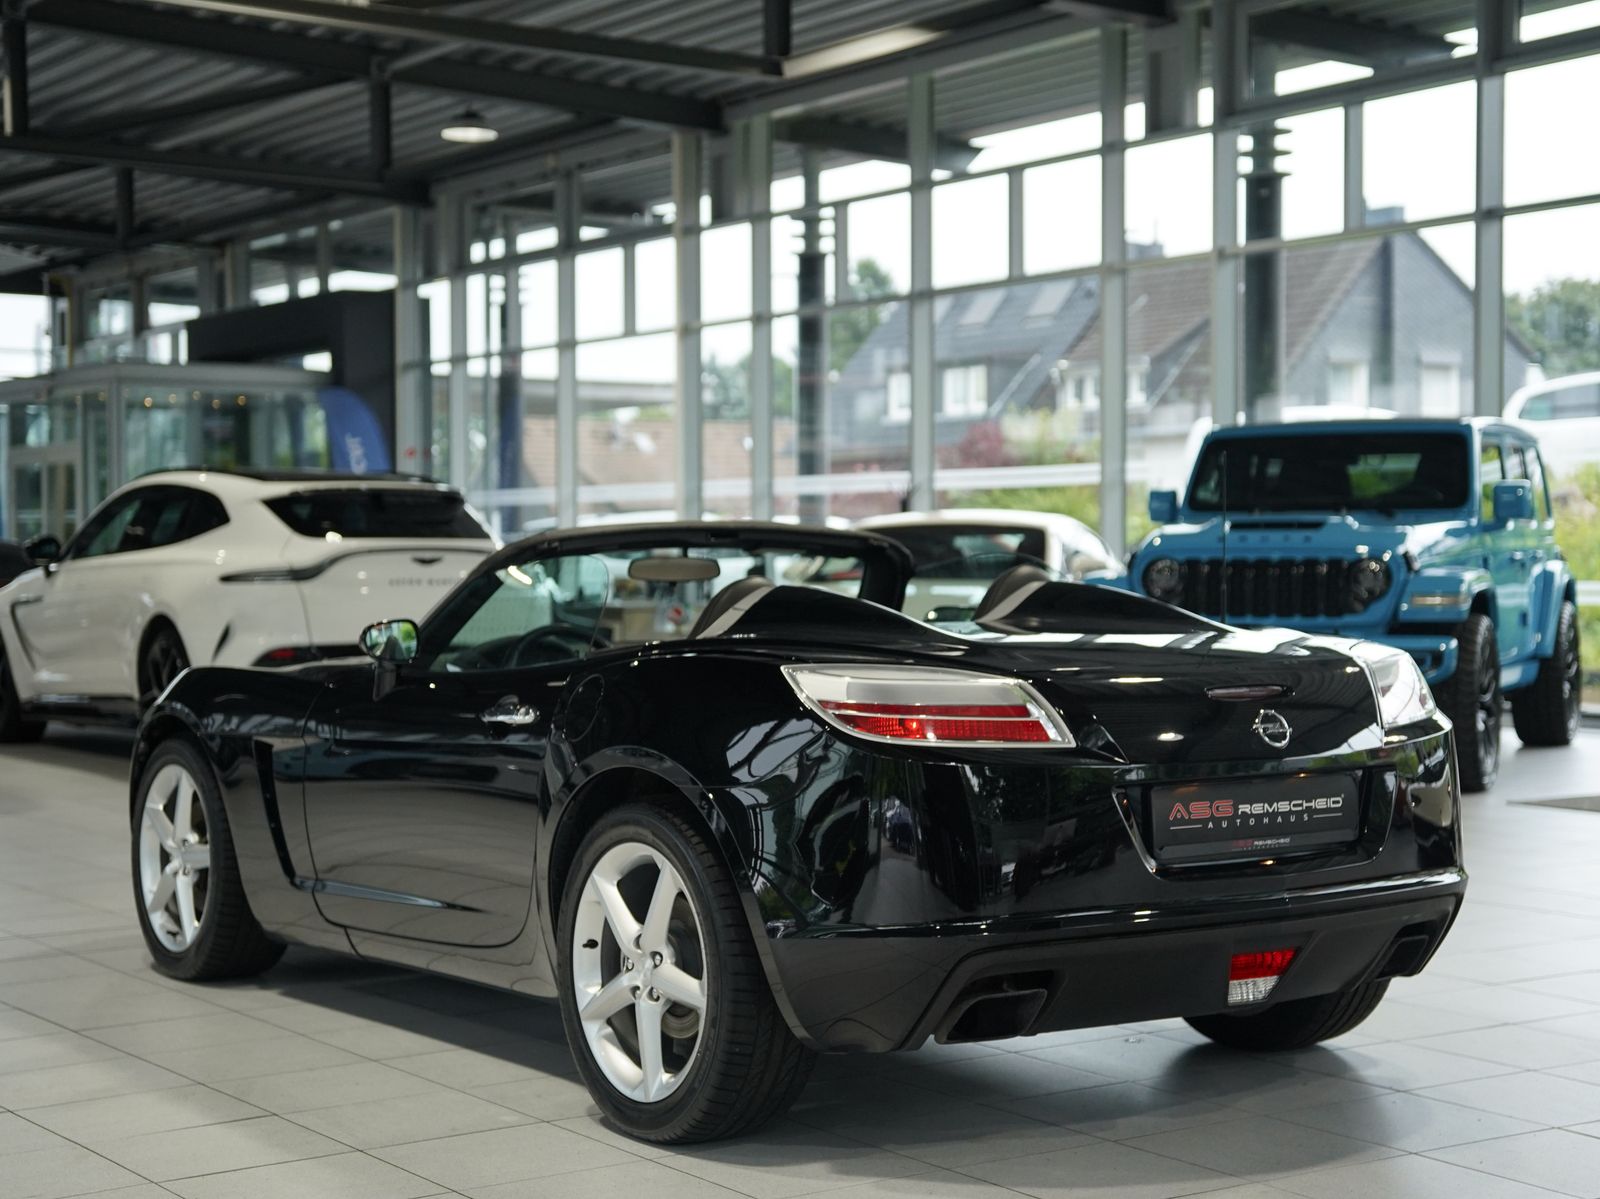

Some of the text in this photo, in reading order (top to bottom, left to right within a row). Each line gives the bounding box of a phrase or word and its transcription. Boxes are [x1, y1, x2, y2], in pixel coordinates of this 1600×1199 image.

[1168, 797, 1343, 821] ASG REMSCHEID
[1208, 813, 1309, 829] AUTOHAUS
